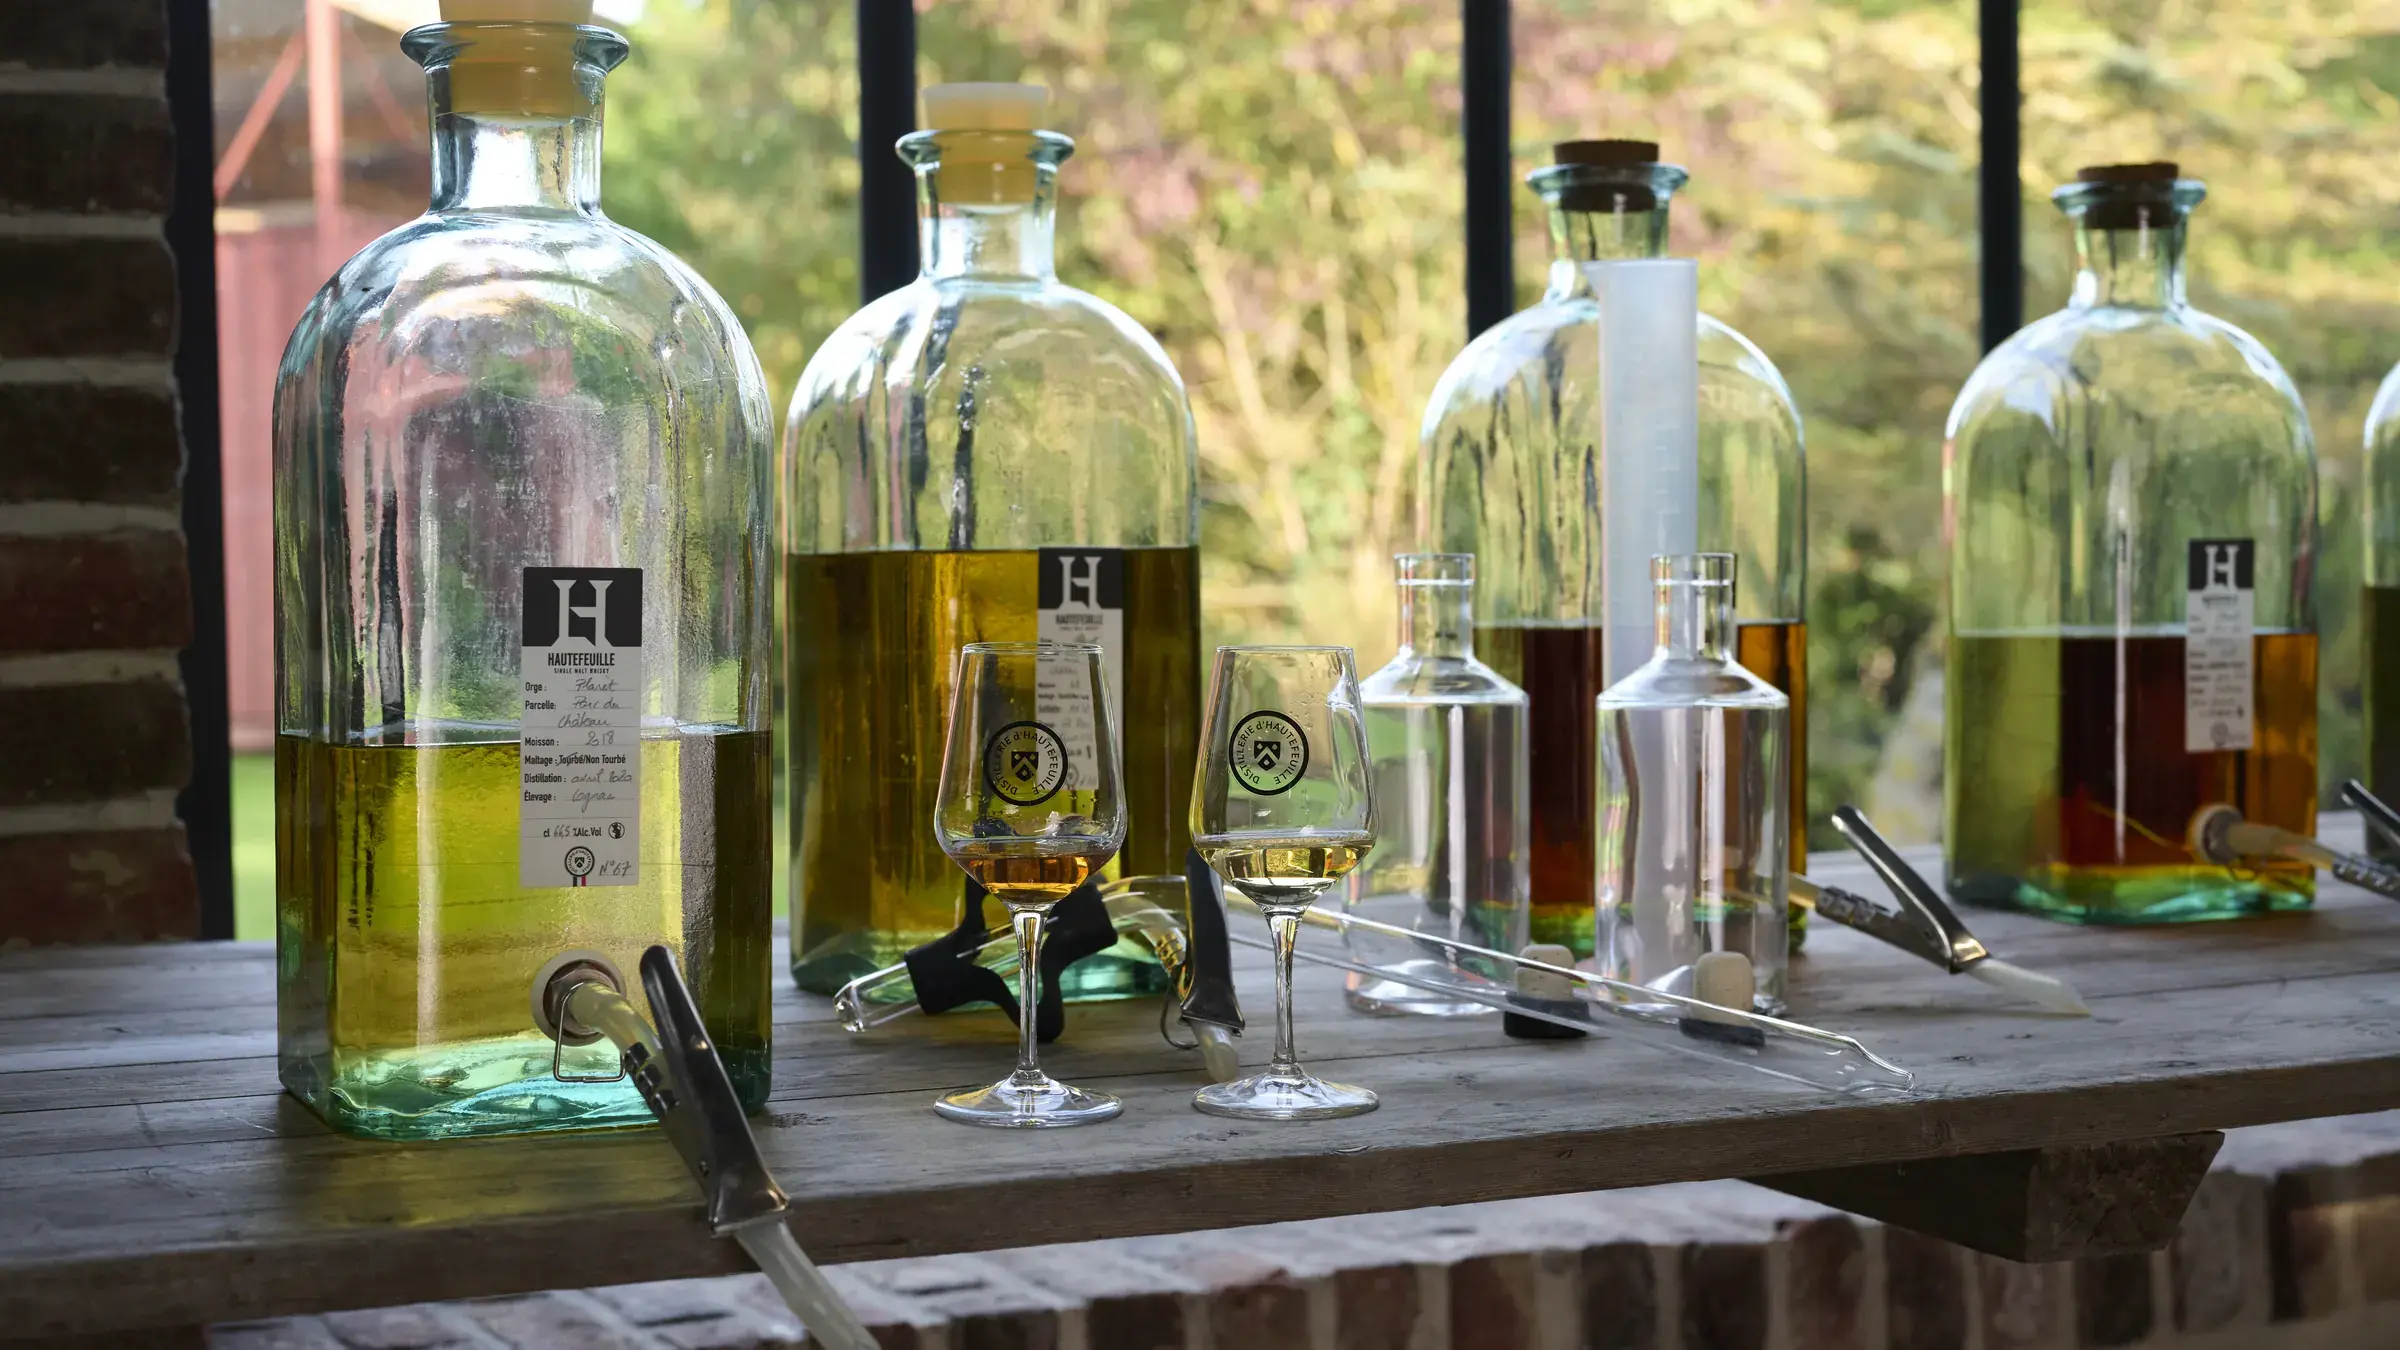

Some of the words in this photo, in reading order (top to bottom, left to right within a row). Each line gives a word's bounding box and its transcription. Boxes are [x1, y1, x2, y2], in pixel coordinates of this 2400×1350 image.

[1058, 556, 1102, 609] H
[551, 579, 614, 649] H
[548, 653, 616, 666] HAUTEFEUILLE
[525, 682, 543, 694] Orge
[525, 737, 555, 747] Moisson
[1237, 726, 1260, 784] DISTILLERIE
[1256, 721, 1300, 785] d'HAUTEFEUILLE
[524, 755, 553, 767] Maltage
[602, 754, 626, 764] Tourbé
[1013, 731, 1059, 795] d'HAUTEFEUILLE
[524, 773, 562, 783] Distillation
[524, 790, 552, 803] Élevage
